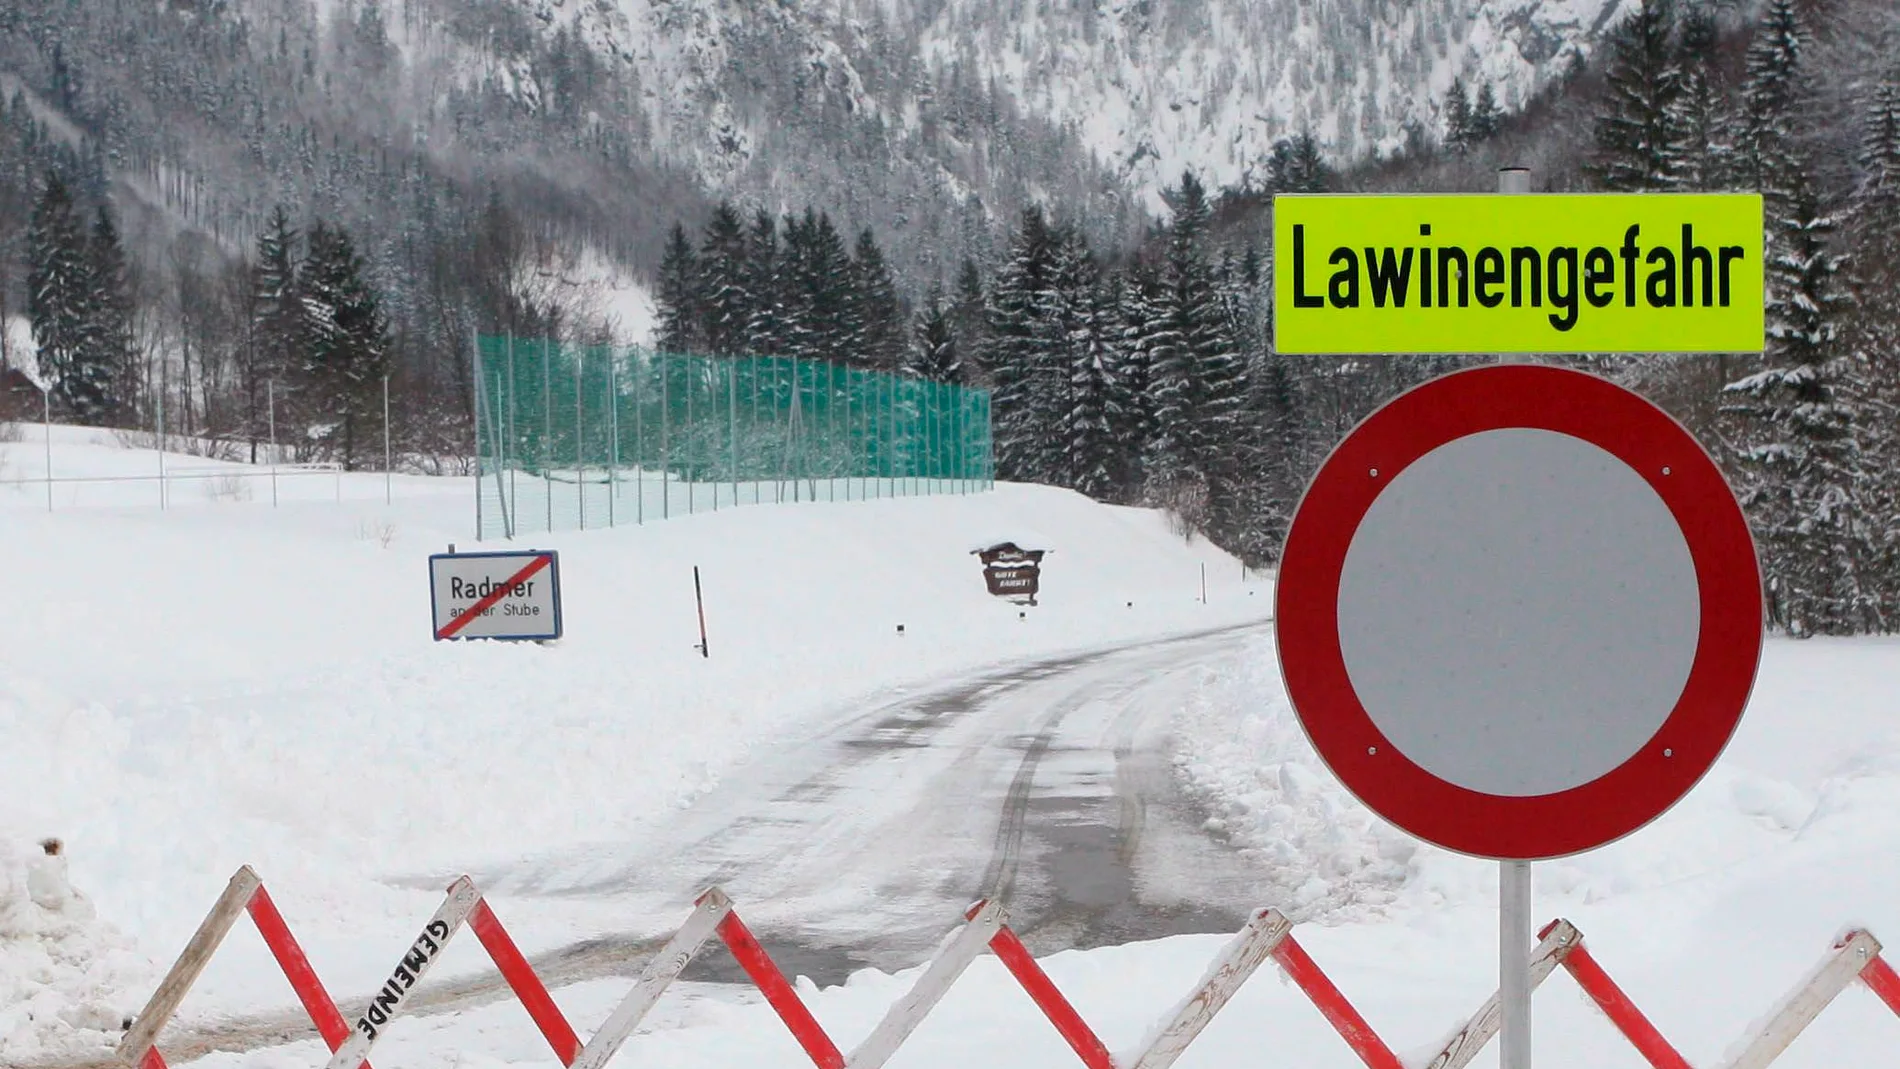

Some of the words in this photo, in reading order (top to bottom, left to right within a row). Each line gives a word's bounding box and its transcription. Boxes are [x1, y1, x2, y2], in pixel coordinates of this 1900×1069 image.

[1292, 223, 1745, 332] Lawinengefahr
[451, 576, 534, 599] Radmer
[503, 603, 541, 616] Stube
[357, 920, 449, 1041] GEMEINDE
